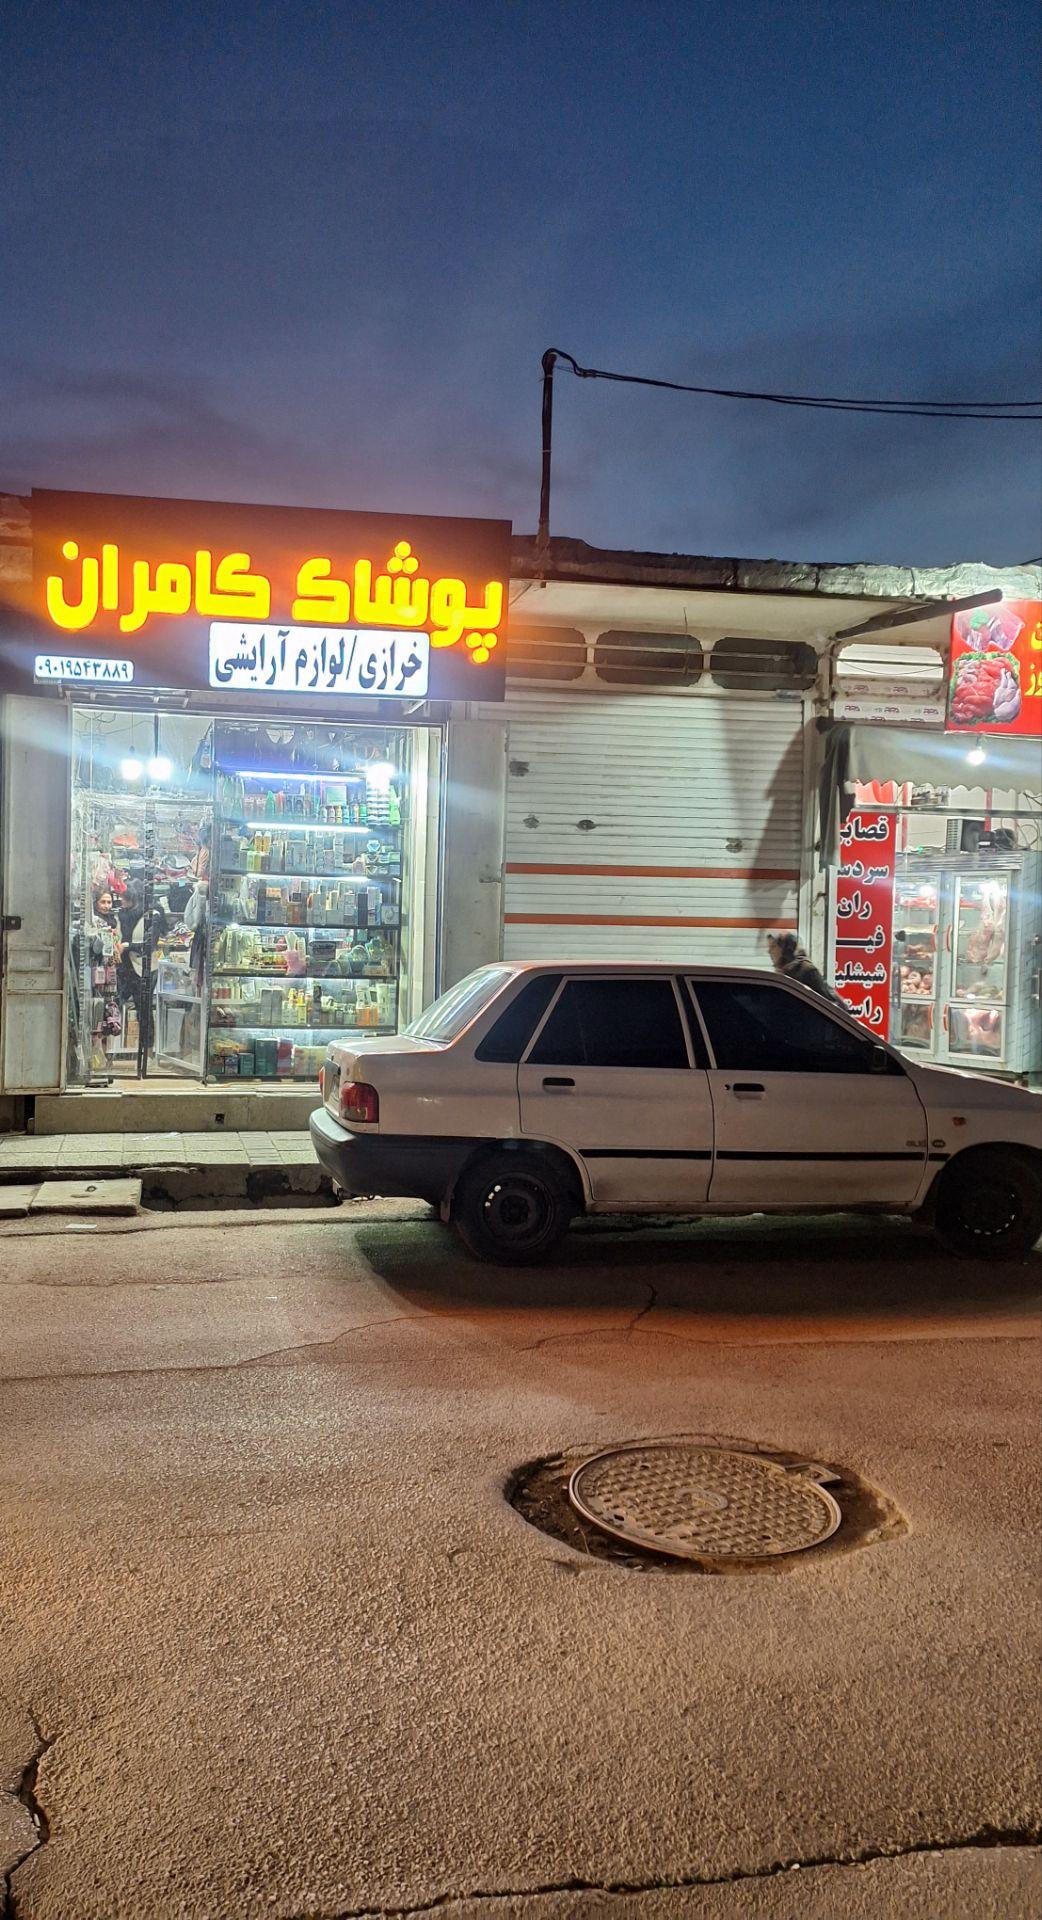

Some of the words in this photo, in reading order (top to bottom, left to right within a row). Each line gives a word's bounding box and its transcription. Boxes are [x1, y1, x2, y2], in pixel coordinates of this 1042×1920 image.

[46, 541, 271, 632] کامران
[292, 541, 503, 663] پوشاک
[38, 658, 129, 679] ۰۹۰۱۹۵۴۳۸۸۹
[215, 630, 290, 686] آرایشی
[840, 815, 889, 846] قصاب
[837, 860, 889, 885] سردس
[837, 891, 872, 919] ران
[835, 961, 887, 988] شیشلی
